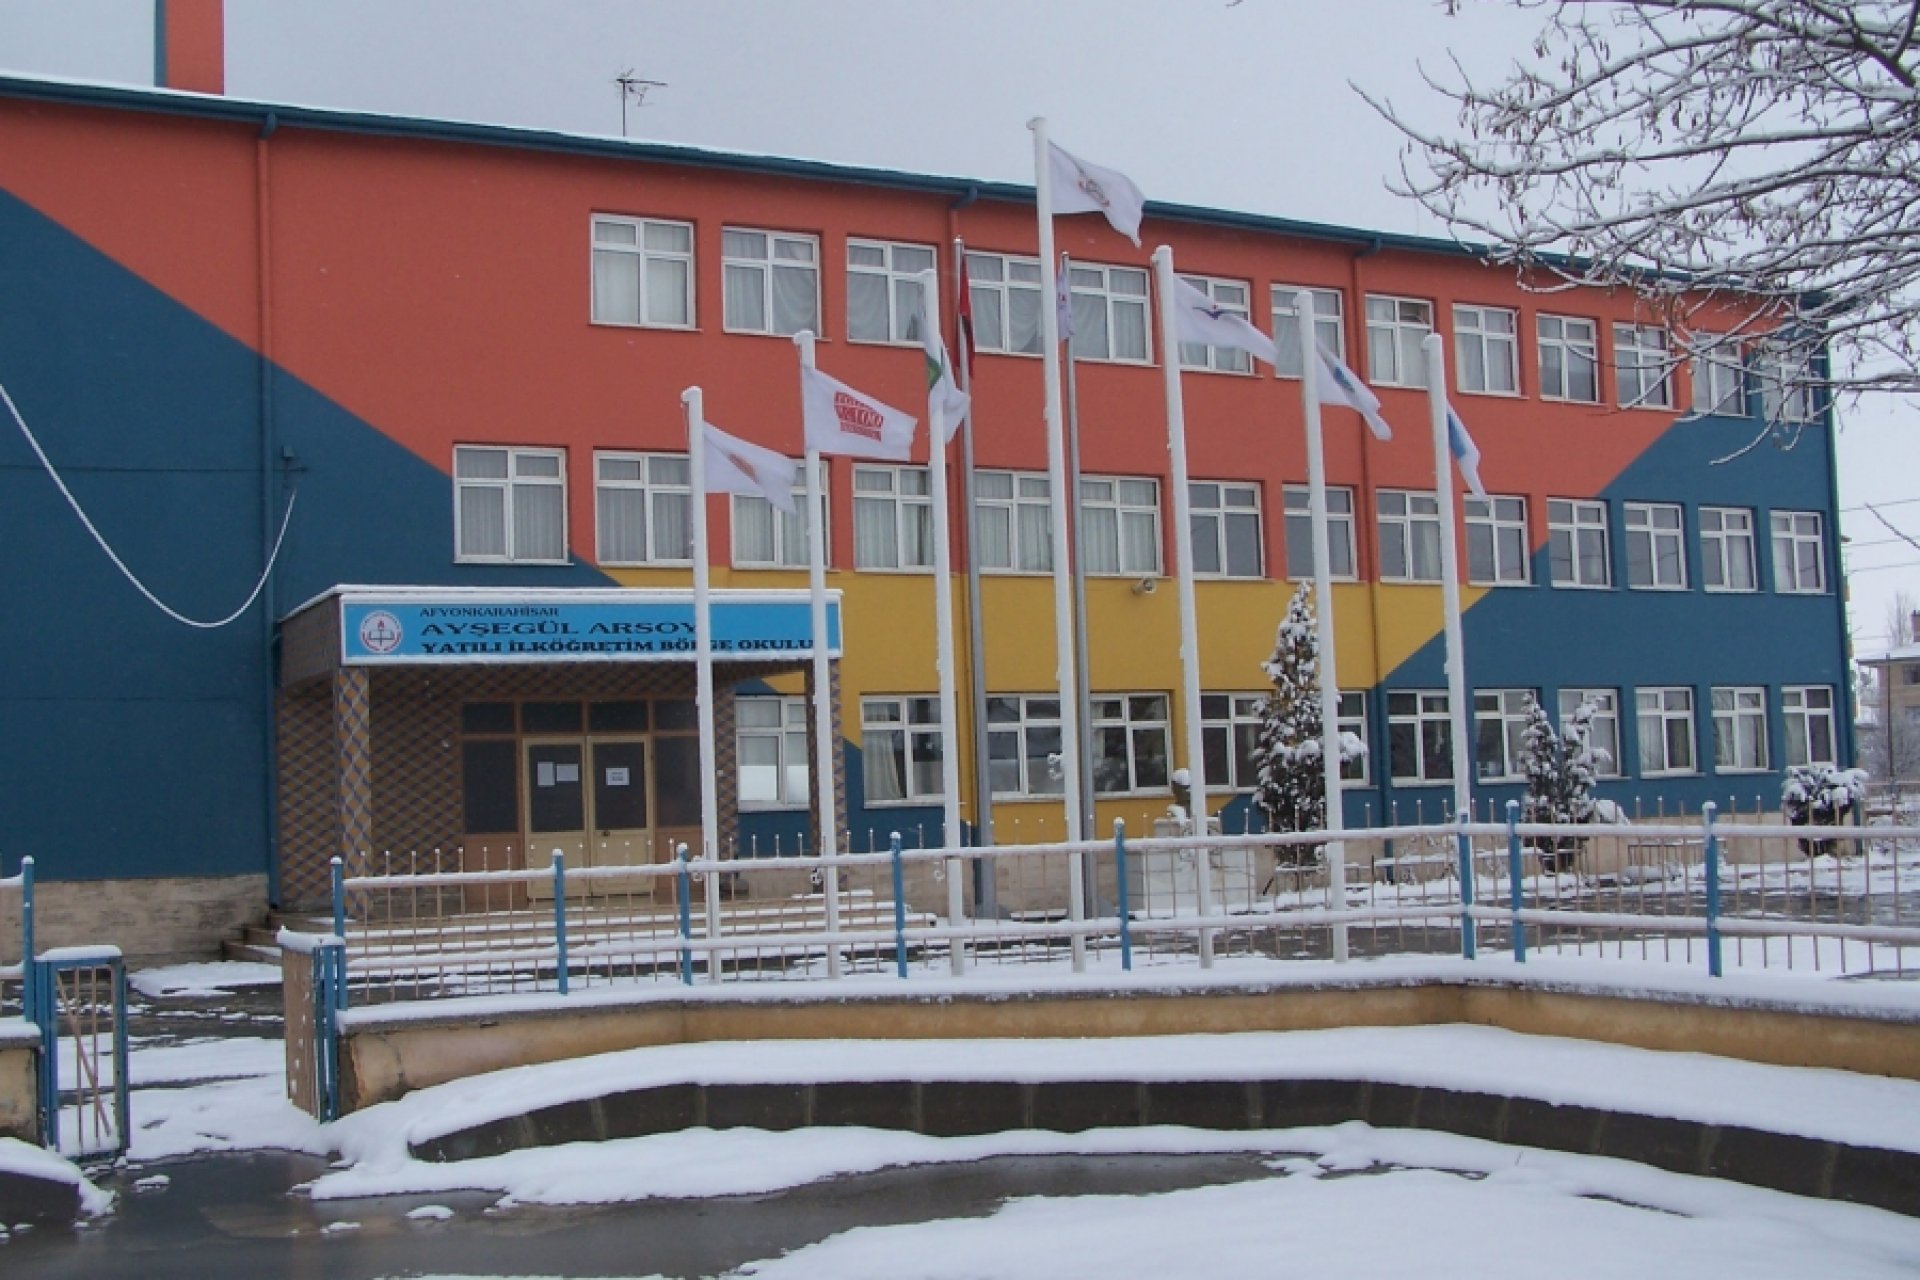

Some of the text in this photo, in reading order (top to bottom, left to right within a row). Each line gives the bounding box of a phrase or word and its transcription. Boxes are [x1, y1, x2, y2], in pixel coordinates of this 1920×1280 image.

[420, 606, 559, 617] AFYONKARAHİSAR
[420, 621, 696, 638] AYŞEGÜL ARSOY
[421, 641, 502, 653] YATILI
[509, 638, 654, 652] İLKÖĞRETİM
[738, 639, 813, 650] OKULU
